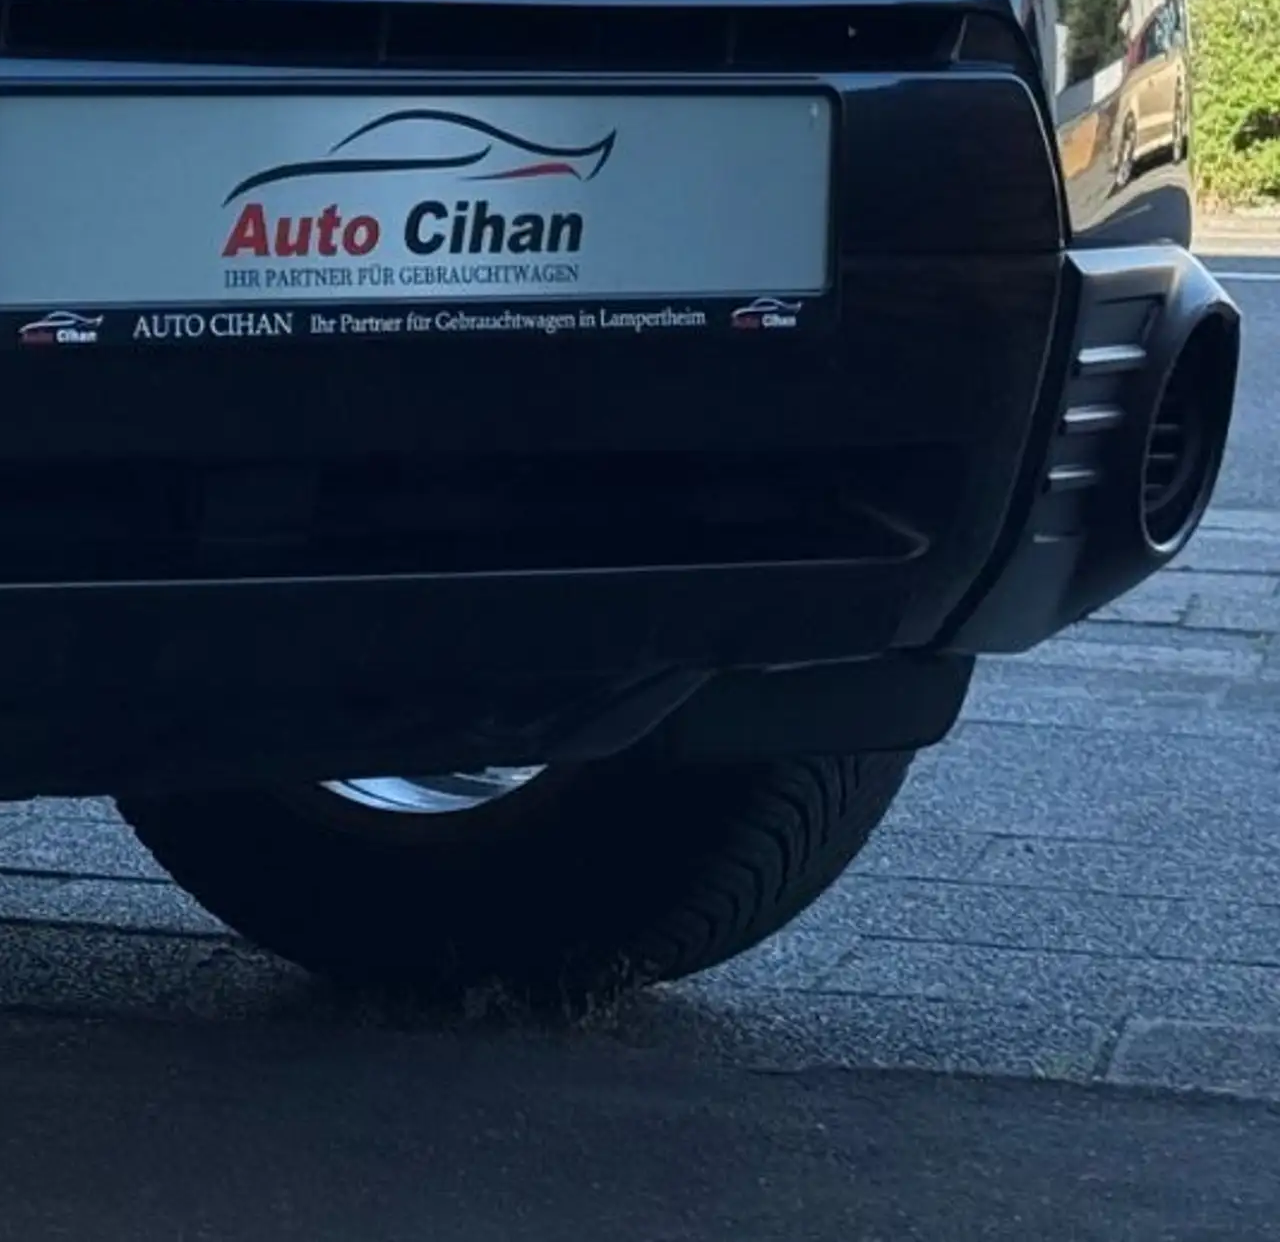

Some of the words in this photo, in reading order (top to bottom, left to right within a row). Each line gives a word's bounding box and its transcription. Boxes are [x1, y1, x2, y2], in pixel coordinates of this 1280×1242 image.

[221, 202, 381, 258] Auto
[404, 199, 584, 257] Cihan
[224, 267, 262, 289] IHR
[265, 266, 354, 288] PARTNER
[358, 262, 396, 287] FÜR
[398, 262, 581, 287] GEBRAUCHTWAGEN
[132, 313, 205, 340] AUTO
[209, 311, 294, 338] CIHAN
[309, 312, 338, 335] Ihr
[340, 312, 403, 334] Partner
[406, 309, 433, 332] für
[435, 308, 576, 335] Gebrauchtwagen
[578, 309, 596, 328] in
[600, 306, 706, 333] Lampertheim
